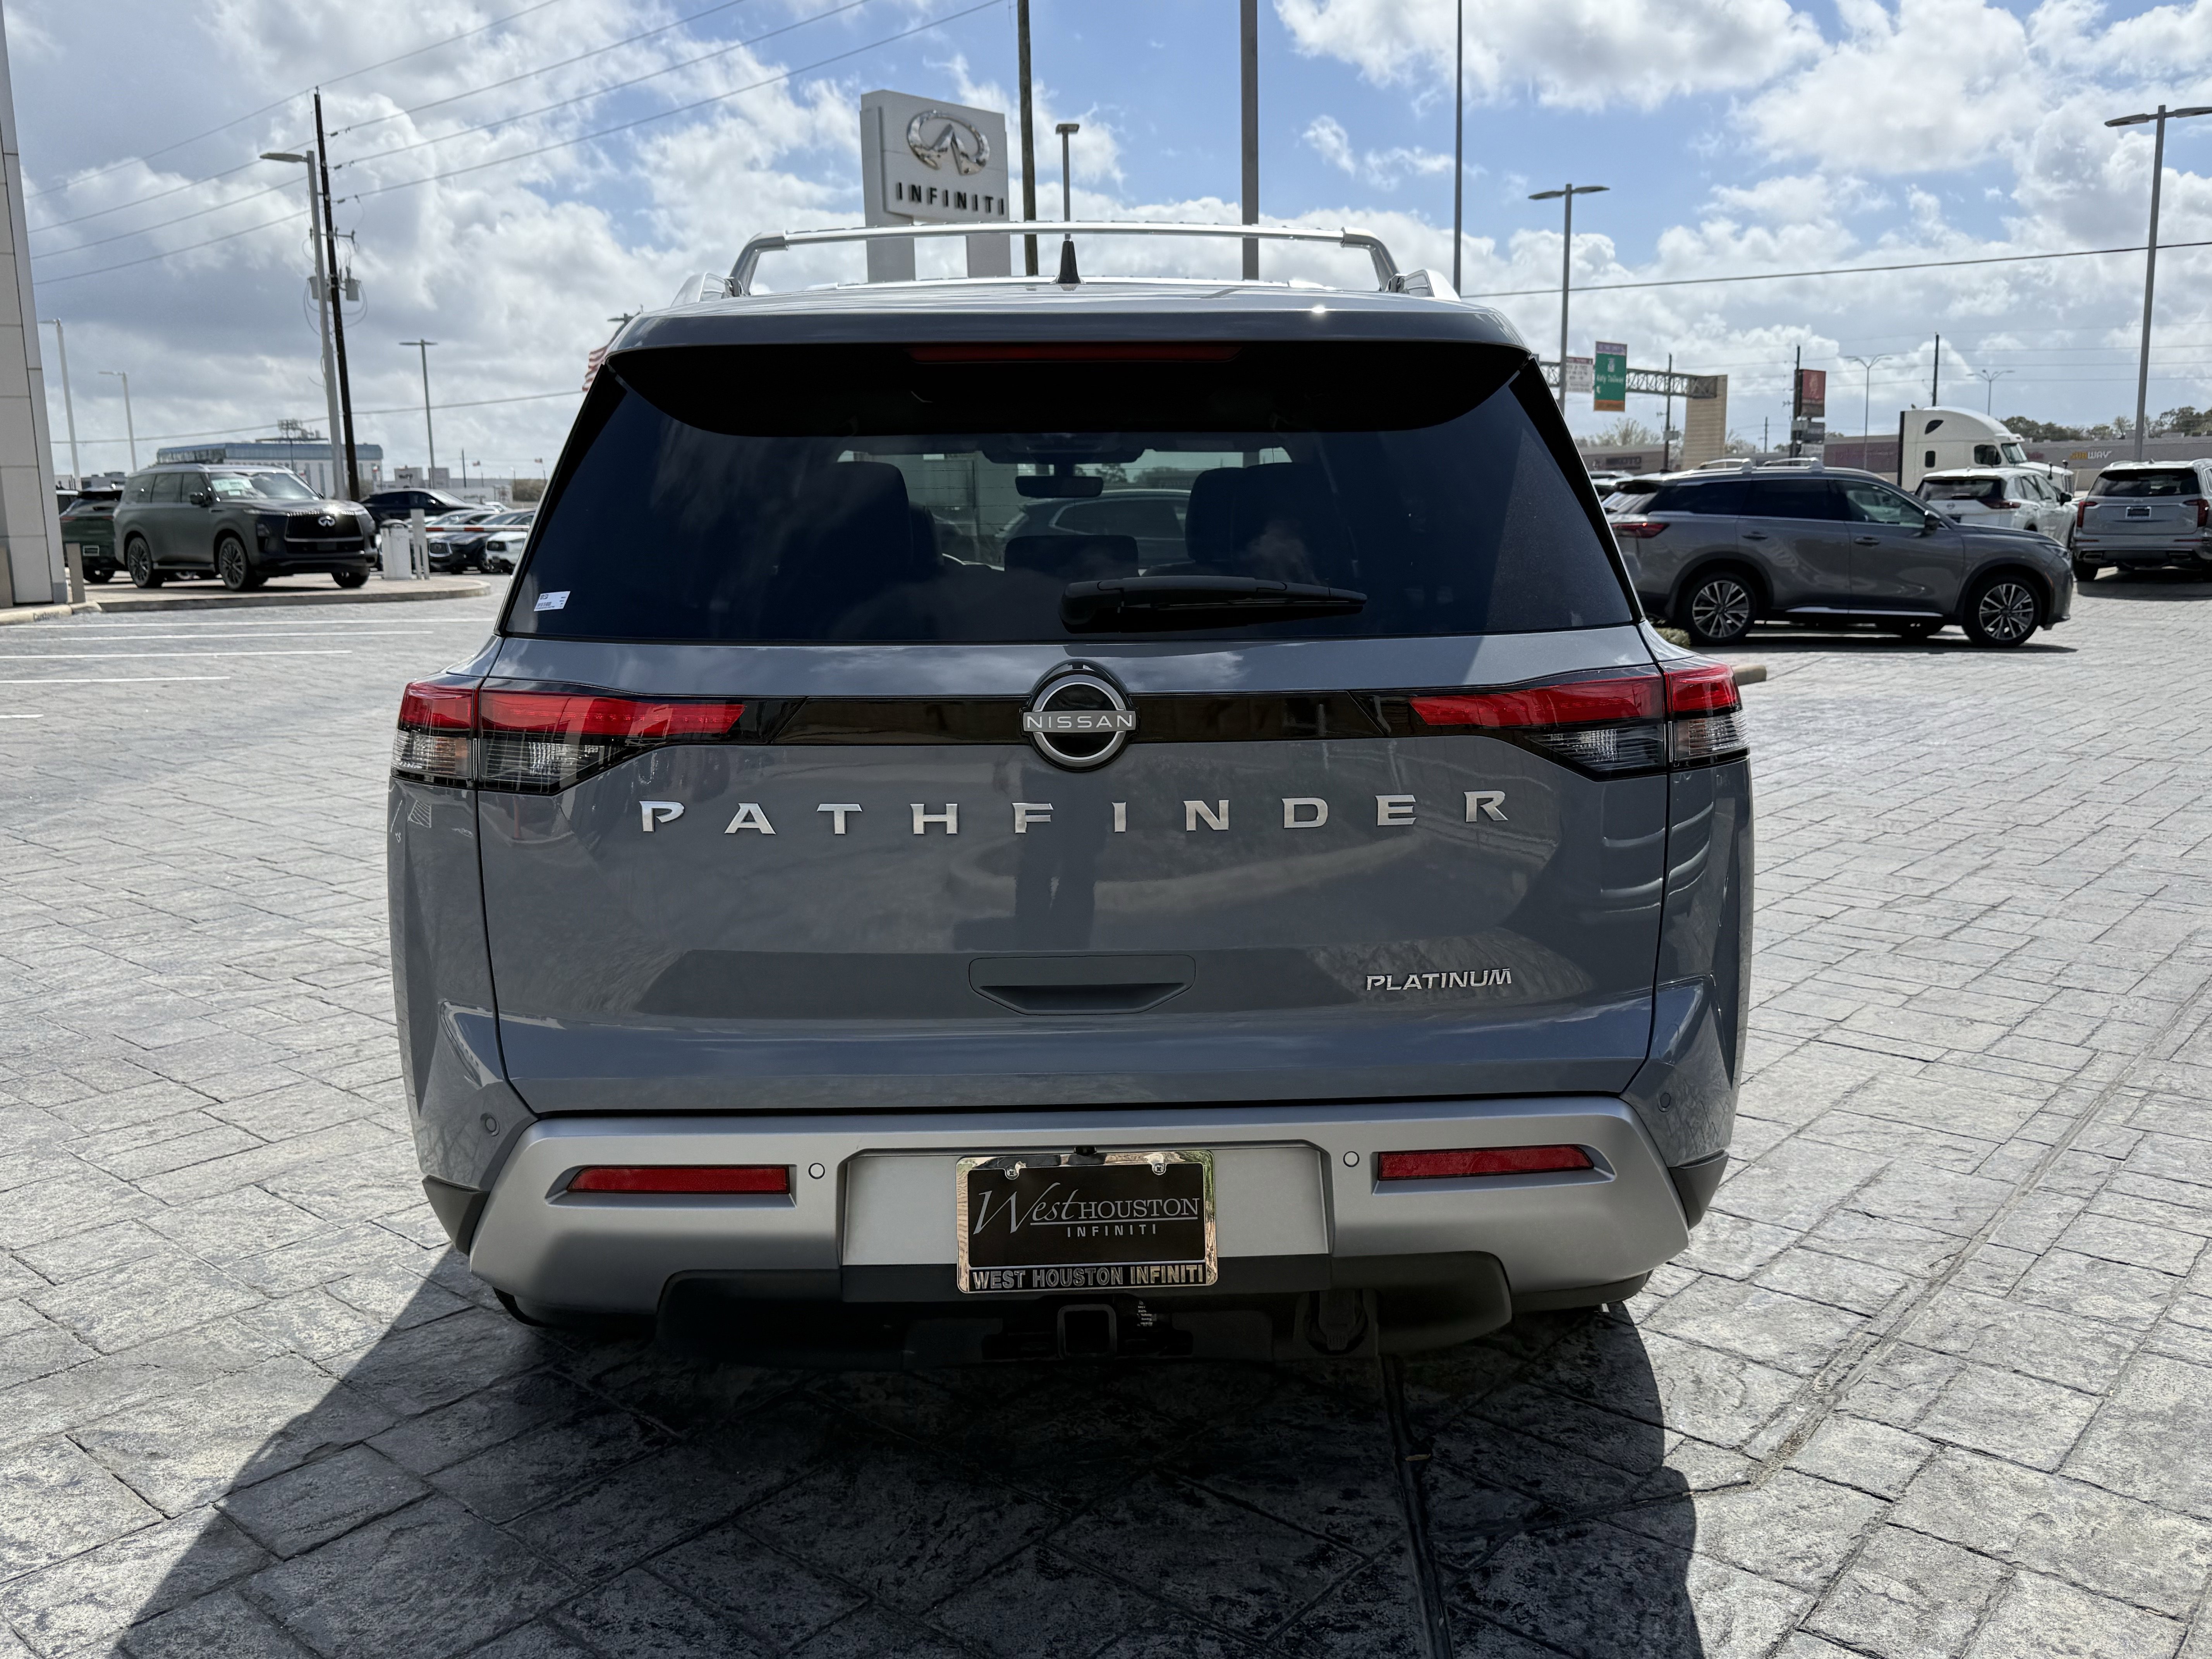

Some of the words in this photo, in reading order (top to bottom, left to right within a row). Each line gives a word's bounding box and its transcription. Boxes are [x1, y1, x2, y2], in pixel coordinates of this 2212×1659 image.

[896, 182, 1004, 215] INFINITI
[1027, 714, 1132, 728] NISSAN
[639, 790, 1508, 835] PATHFINDER
[1366, 968, 1511, 991] PLATINUM
[973, 1182, 1079, 1235] West
[1079, 1198, 1200, 1219] HOUSTON
[1067, 1224, 1157, 1237] INFINITI
[973, 1270, 1026, 1289] WEST
[1033, 1266, 1124, 1288] HOUSTON
[1130, 1264, 1203, 1285] INFINITI
